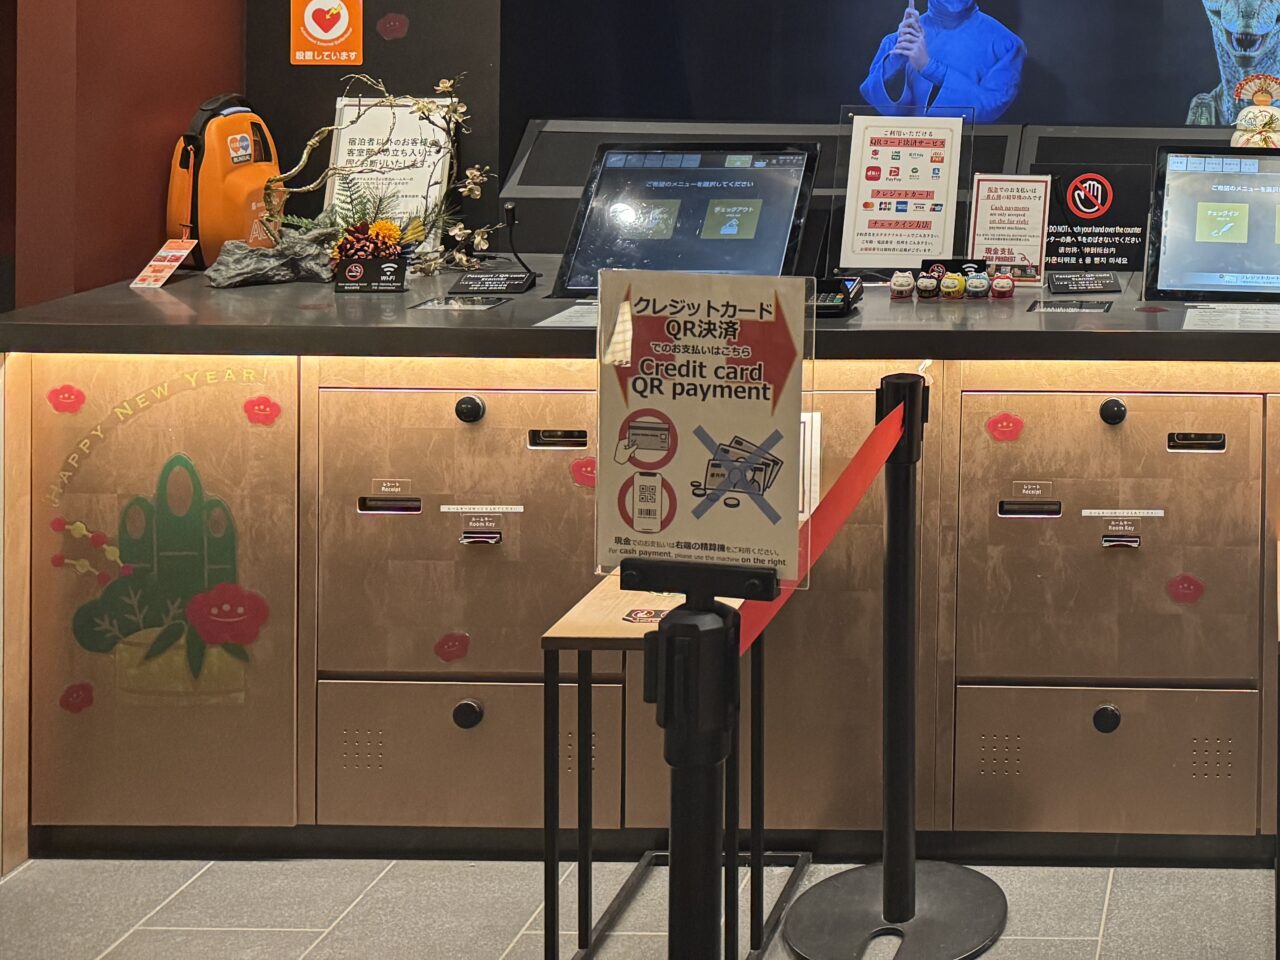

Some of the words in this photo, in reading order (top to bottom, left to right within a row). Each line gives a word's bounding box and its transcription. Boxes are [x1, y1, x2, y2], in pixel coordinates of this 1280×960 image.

[295, 51, 358, 60] 設置しています
[870, 139, 945, 148] QRコード決済サービス
[872, 220, 930, 229] チェックイン方法
[1049, 225, 1058, 233] DO
[1058, 225, 1068, 233] NOT
[1081, 226, 1092, 234] your
[985, 247, 1015, 255] 現金支払
[633, 296, 773, 320] クレジットカード
[665, 319, 740, 340] QR決済
[651, 342, 752, 357] でのお支払いはこちら
[639, 358, 707, 379] Credit
[713, 362, 763, 381] card
[631, 376, 665, 396] QR
[672, 381, 771, 401] payment
[45, 425, 107, 507] HAPPY
[113, 383, 169, 421] NEW
[186, 367, 269, 388] YEAR!
[619, 548, 637, 556] cash
[674, 553, 692, 561] please
[716, 554, 739, 562] machine
[753, 556, 766, 564] the
[767, 557, 787, 567] right
